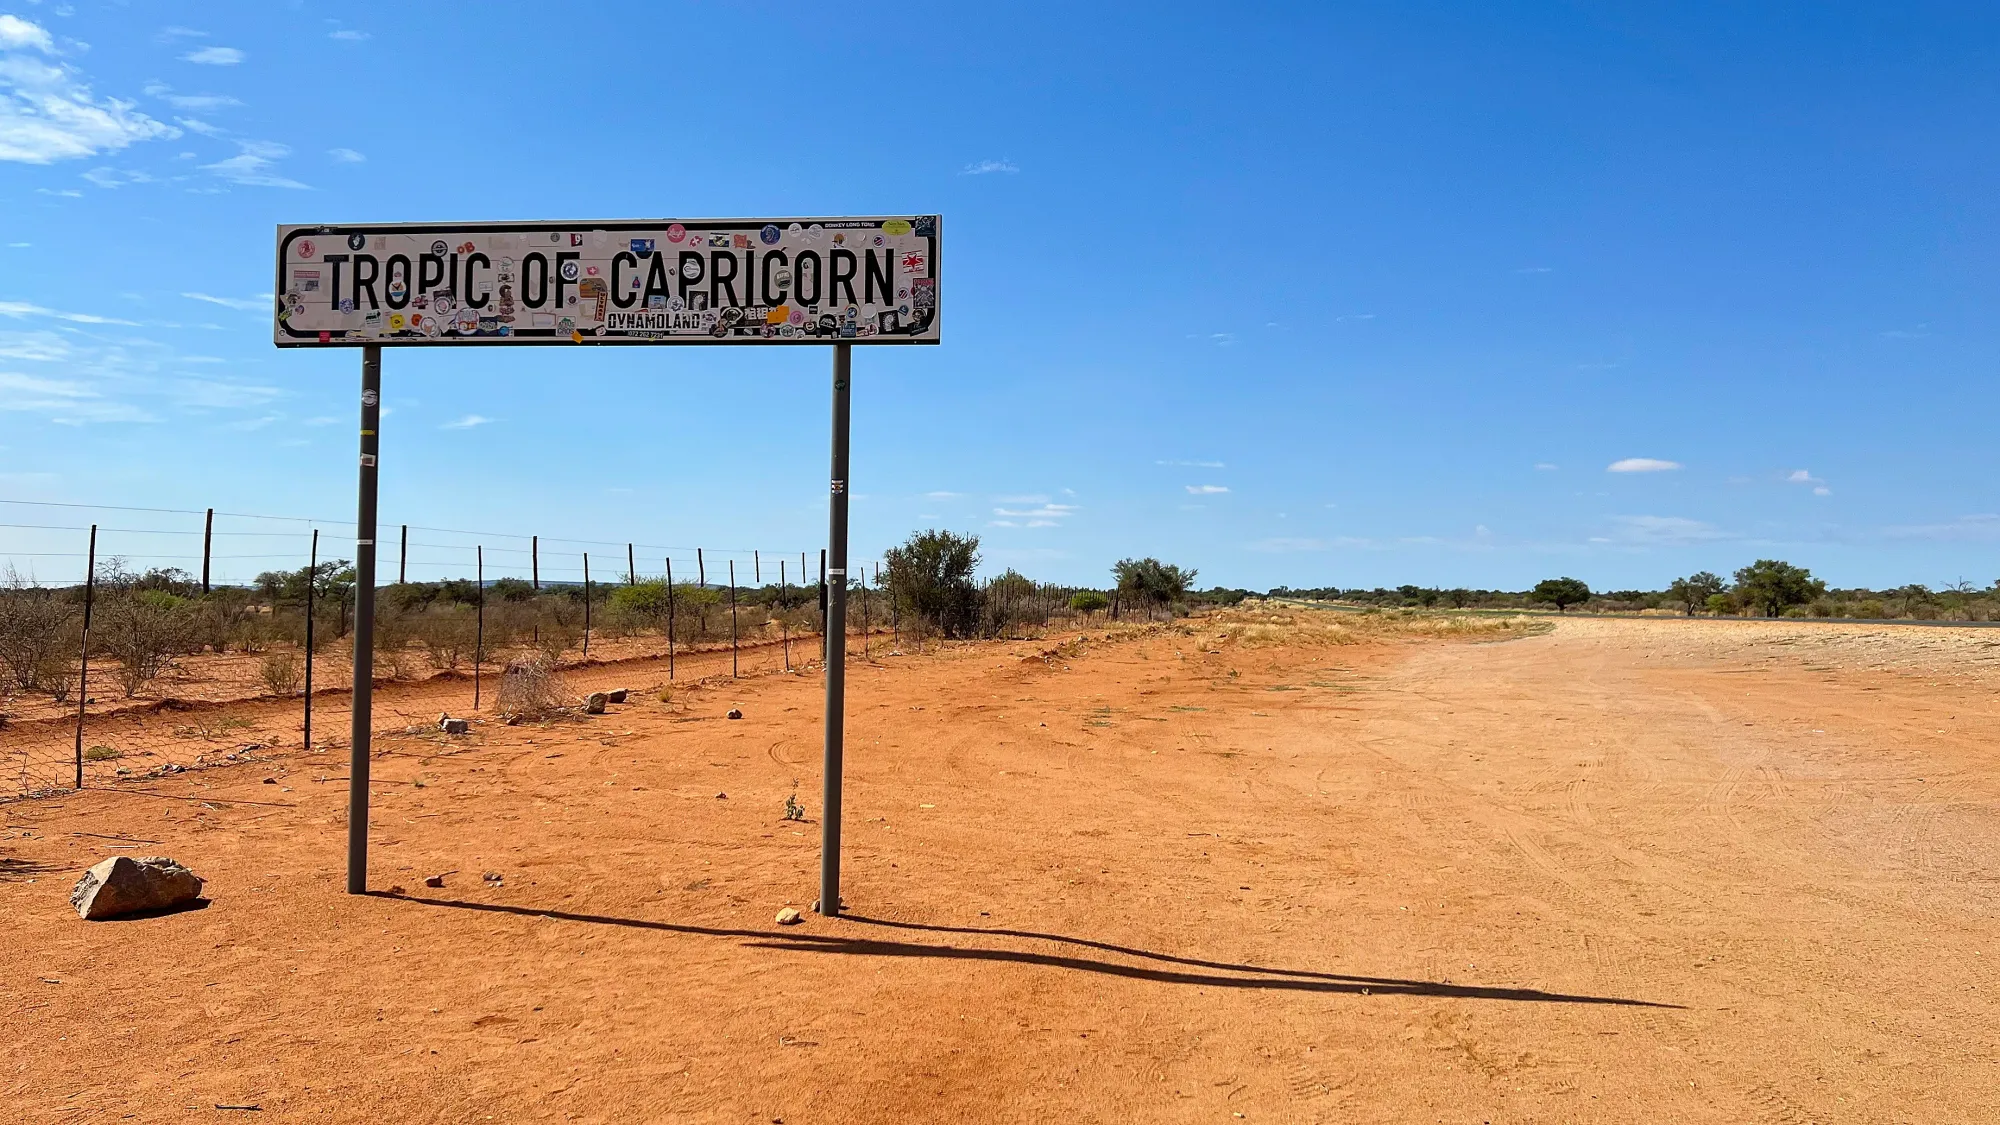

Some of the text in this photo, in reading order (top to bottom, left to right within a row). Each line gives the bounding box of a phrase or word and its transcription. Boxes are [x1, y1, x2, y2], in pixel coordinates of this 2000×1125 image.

[324, 248, 894, 310] TROPIC OF CAPRICORN
[608, 313, 700, 329] DYNAMOLAND
